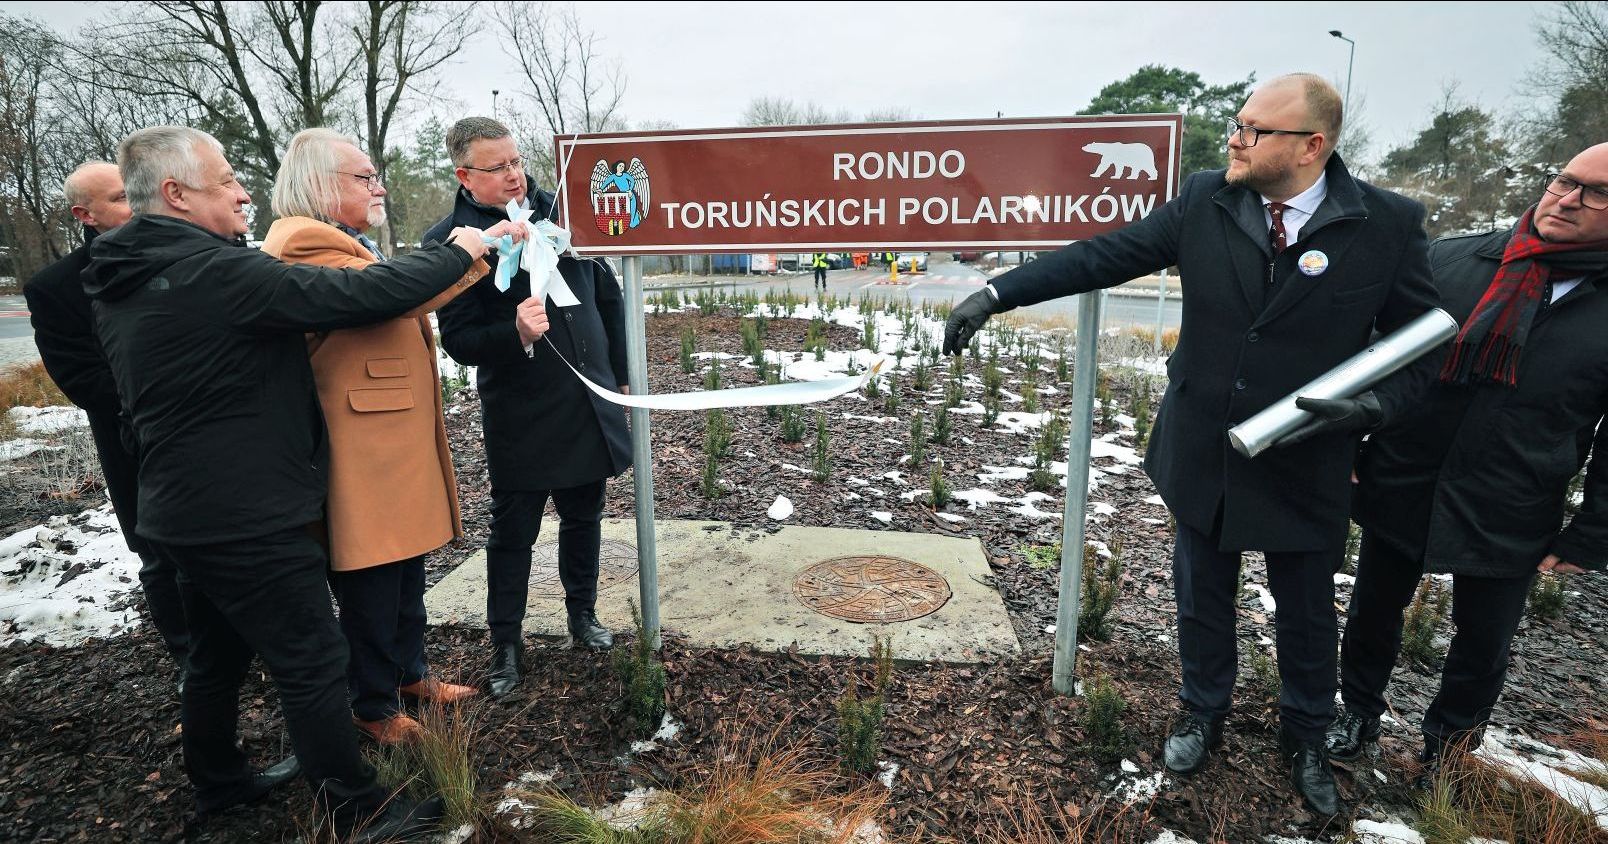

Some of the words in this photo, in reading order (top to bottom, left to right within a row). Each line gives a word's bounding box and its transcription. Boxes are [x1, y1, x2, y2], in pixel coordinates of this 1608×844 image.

[833, 149, 966, 180] RONDO
[660, 193, 886, 229] TORUŃSKICH
[899, 186, 1157, 225] POLARNIKÓW
